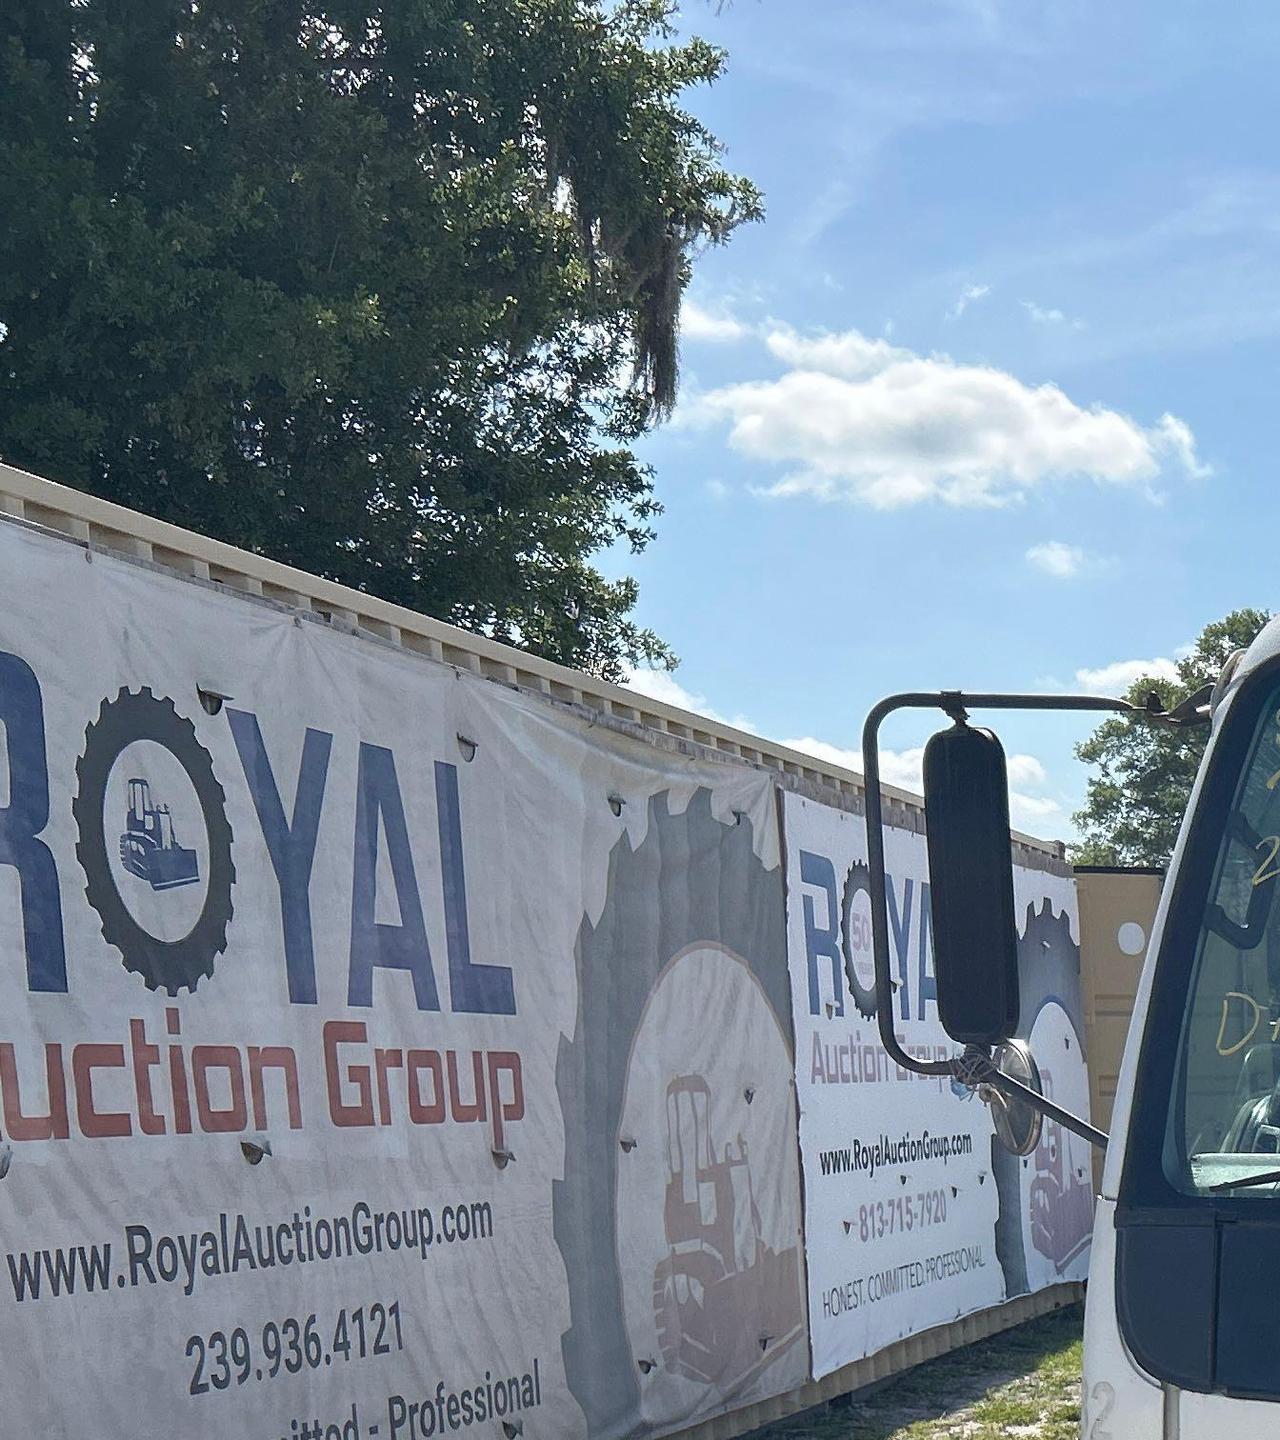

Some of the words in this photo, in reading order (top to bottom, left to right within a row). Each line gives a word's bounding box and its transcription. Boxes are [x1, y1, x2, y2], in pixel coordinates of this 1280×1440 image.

[800, 849, 938, 1021] ROYA
[0, 1007, 302, 1141] uction
[323, 1020, 525, 1151] Group
[811, 1029, 889, 1084] Auction
[820, 1130, 973, 1178] www.RoyalAuctionGroup.com
[7, 1201, 494, 1302] www.RoyalAuctionGroup.com
[859, 1189, 947, 1242] 813-715-7920
[925, 1245, 986, 1284] PROFESSIONAL
[185, 1301, 404, 1396] 239.936.4121
